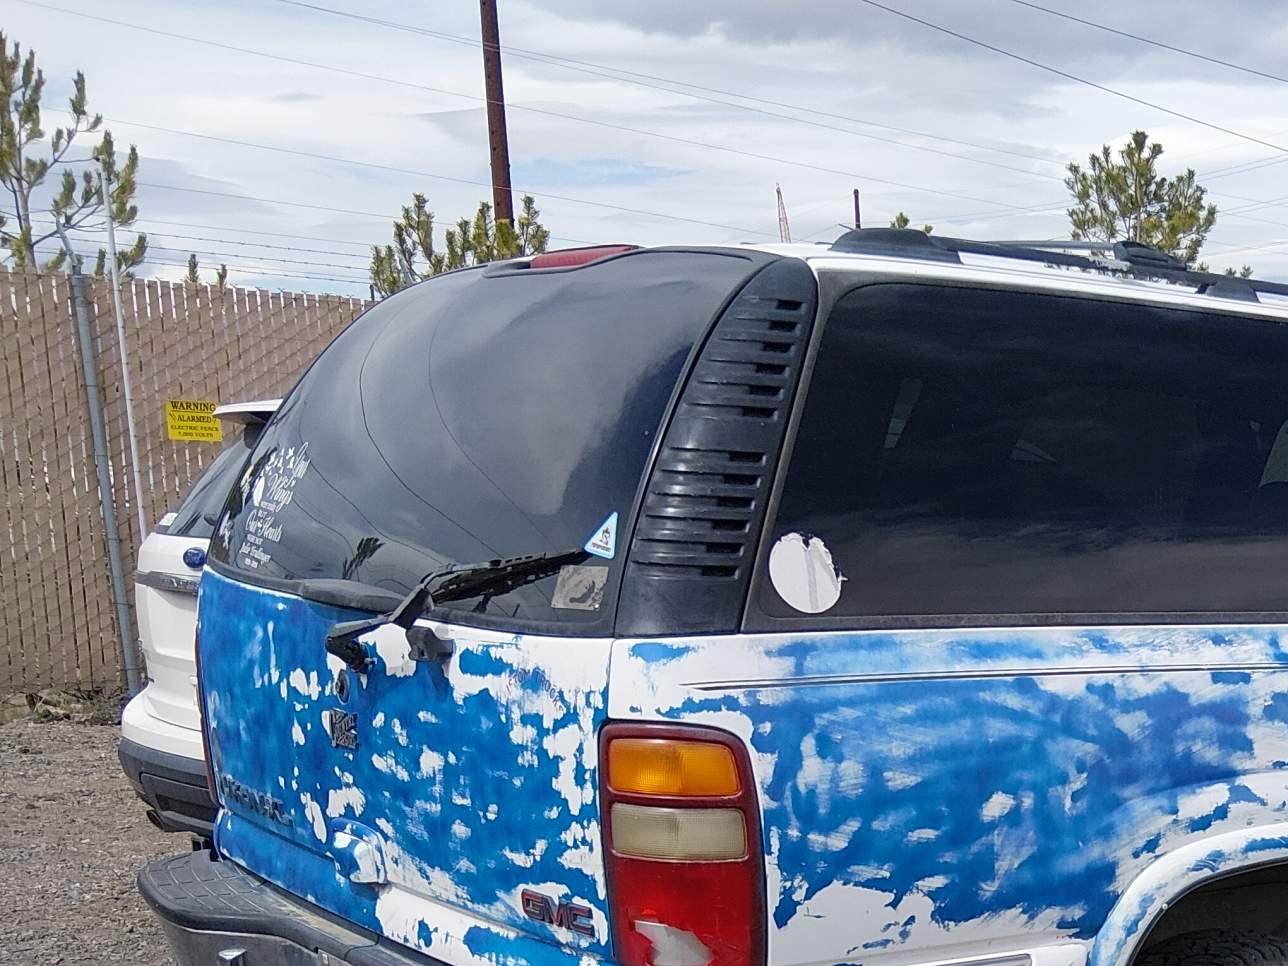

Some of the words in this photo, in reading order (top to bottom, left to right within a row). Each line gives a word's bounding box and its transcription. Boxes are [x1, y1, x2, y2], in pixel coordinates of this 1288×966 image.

[170, 401, 216, 412] WARNING
[177, 415, 212, 424] ALARMED
[521, 888, 596, 938] GMC
